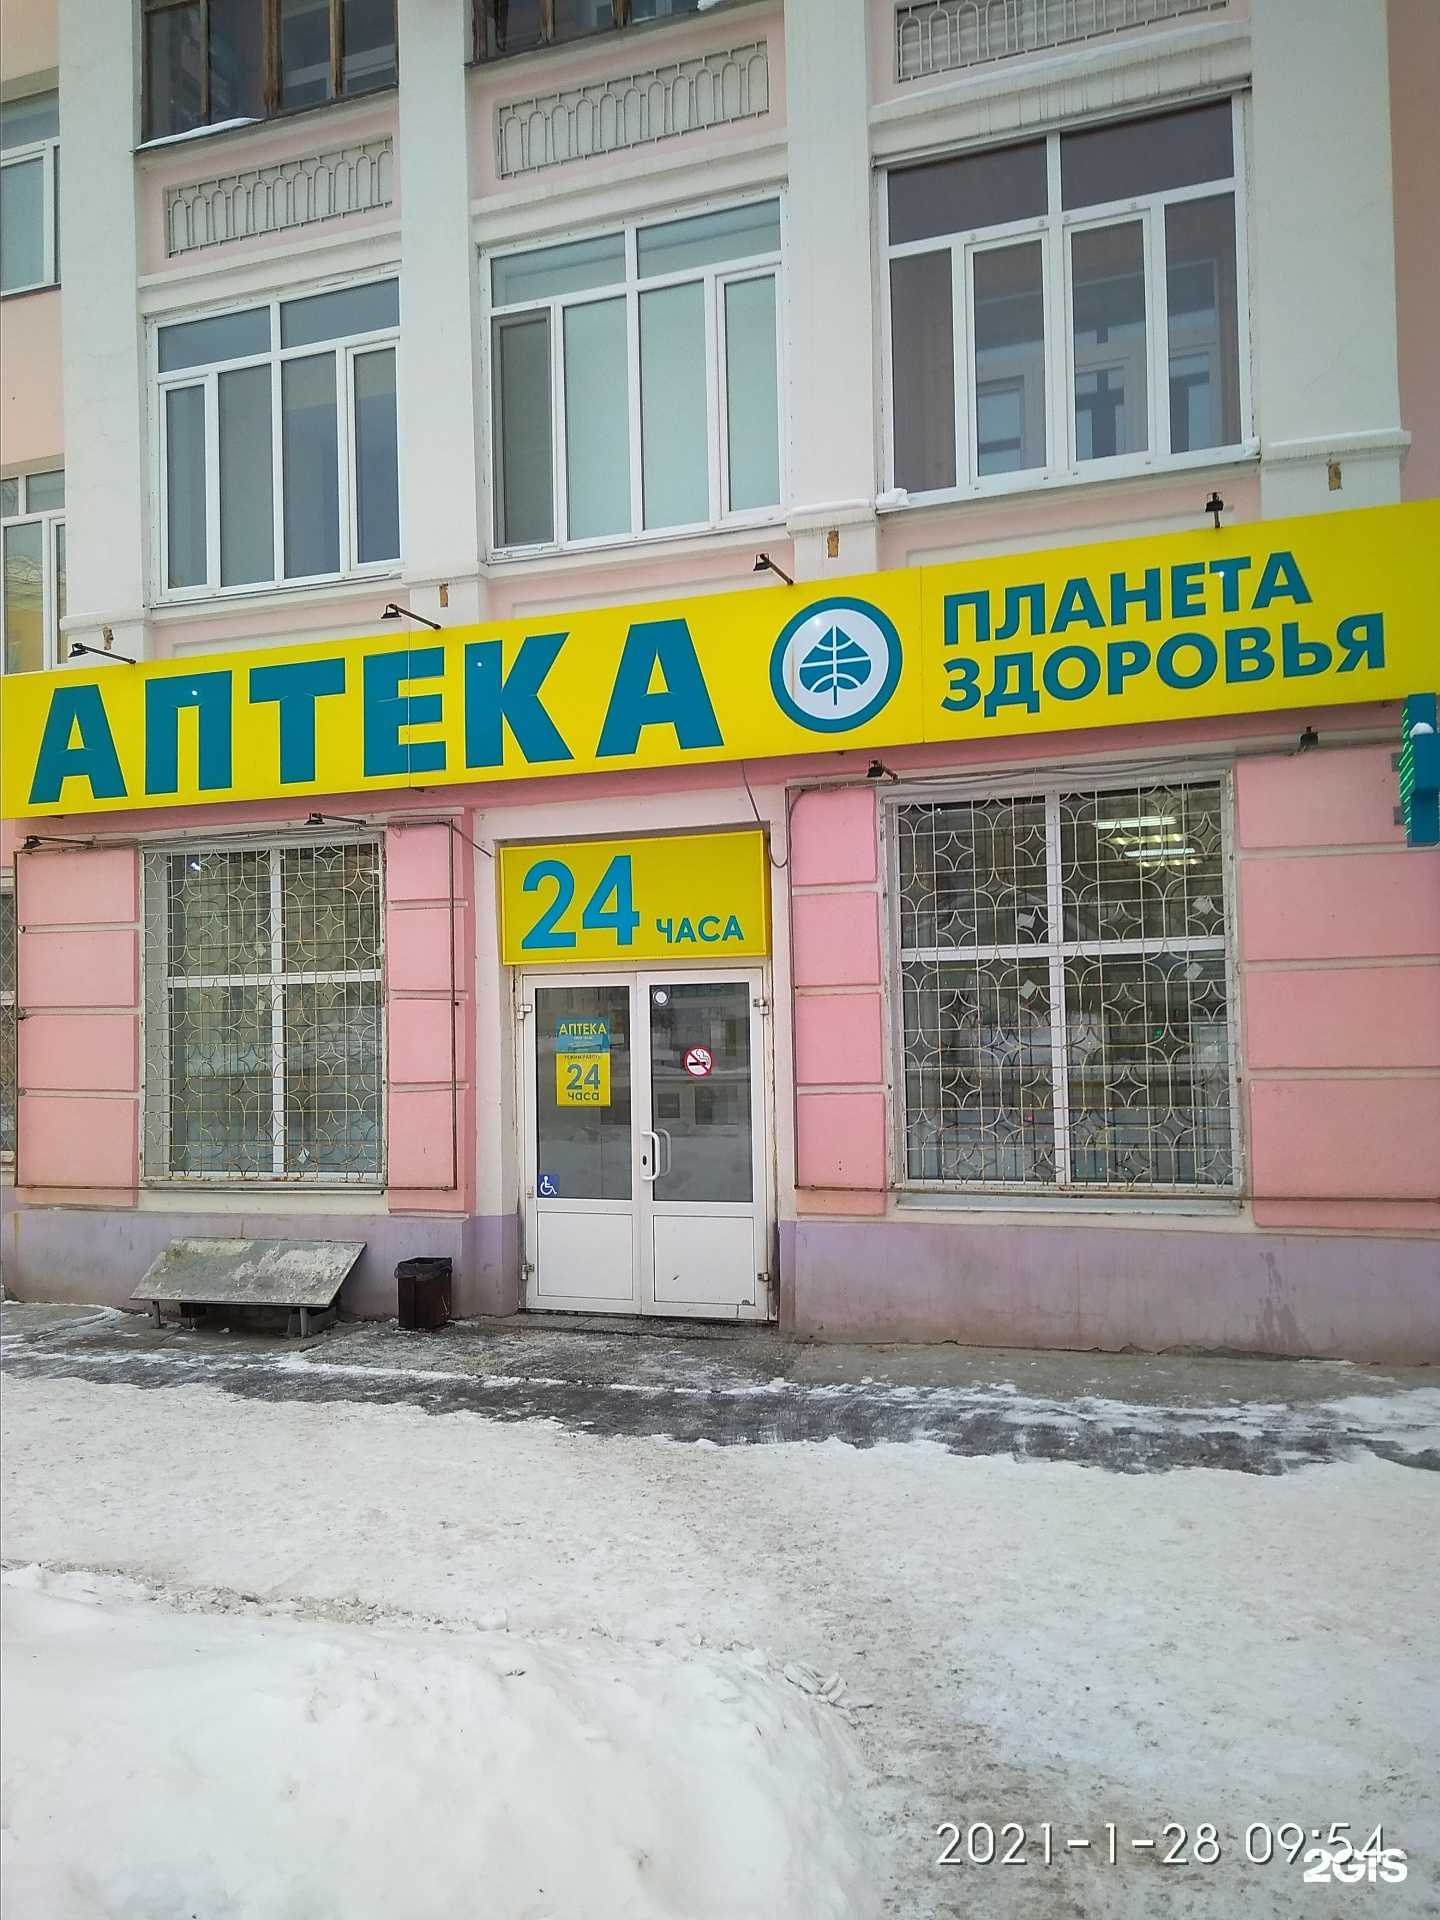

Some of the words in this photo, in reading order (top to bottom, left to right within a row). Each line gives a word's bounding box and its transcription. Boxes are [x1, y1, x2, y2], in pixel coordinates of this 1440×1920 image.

[942, 551, 1312, 645] ПЛАНЕТА
[28, 617, 724, 804] АПТЕКА
[940, 612, 1386, 718] ЗДОРОВЬЯ
[521, 855, 640, 949] 24
[656, 915, 744, 943] ЧАСА
[559, 1023, 607, 1035] АПТЕКА
[566, 1063, 601, 1090] 24
[567, 1092, 600, 1101] часа
